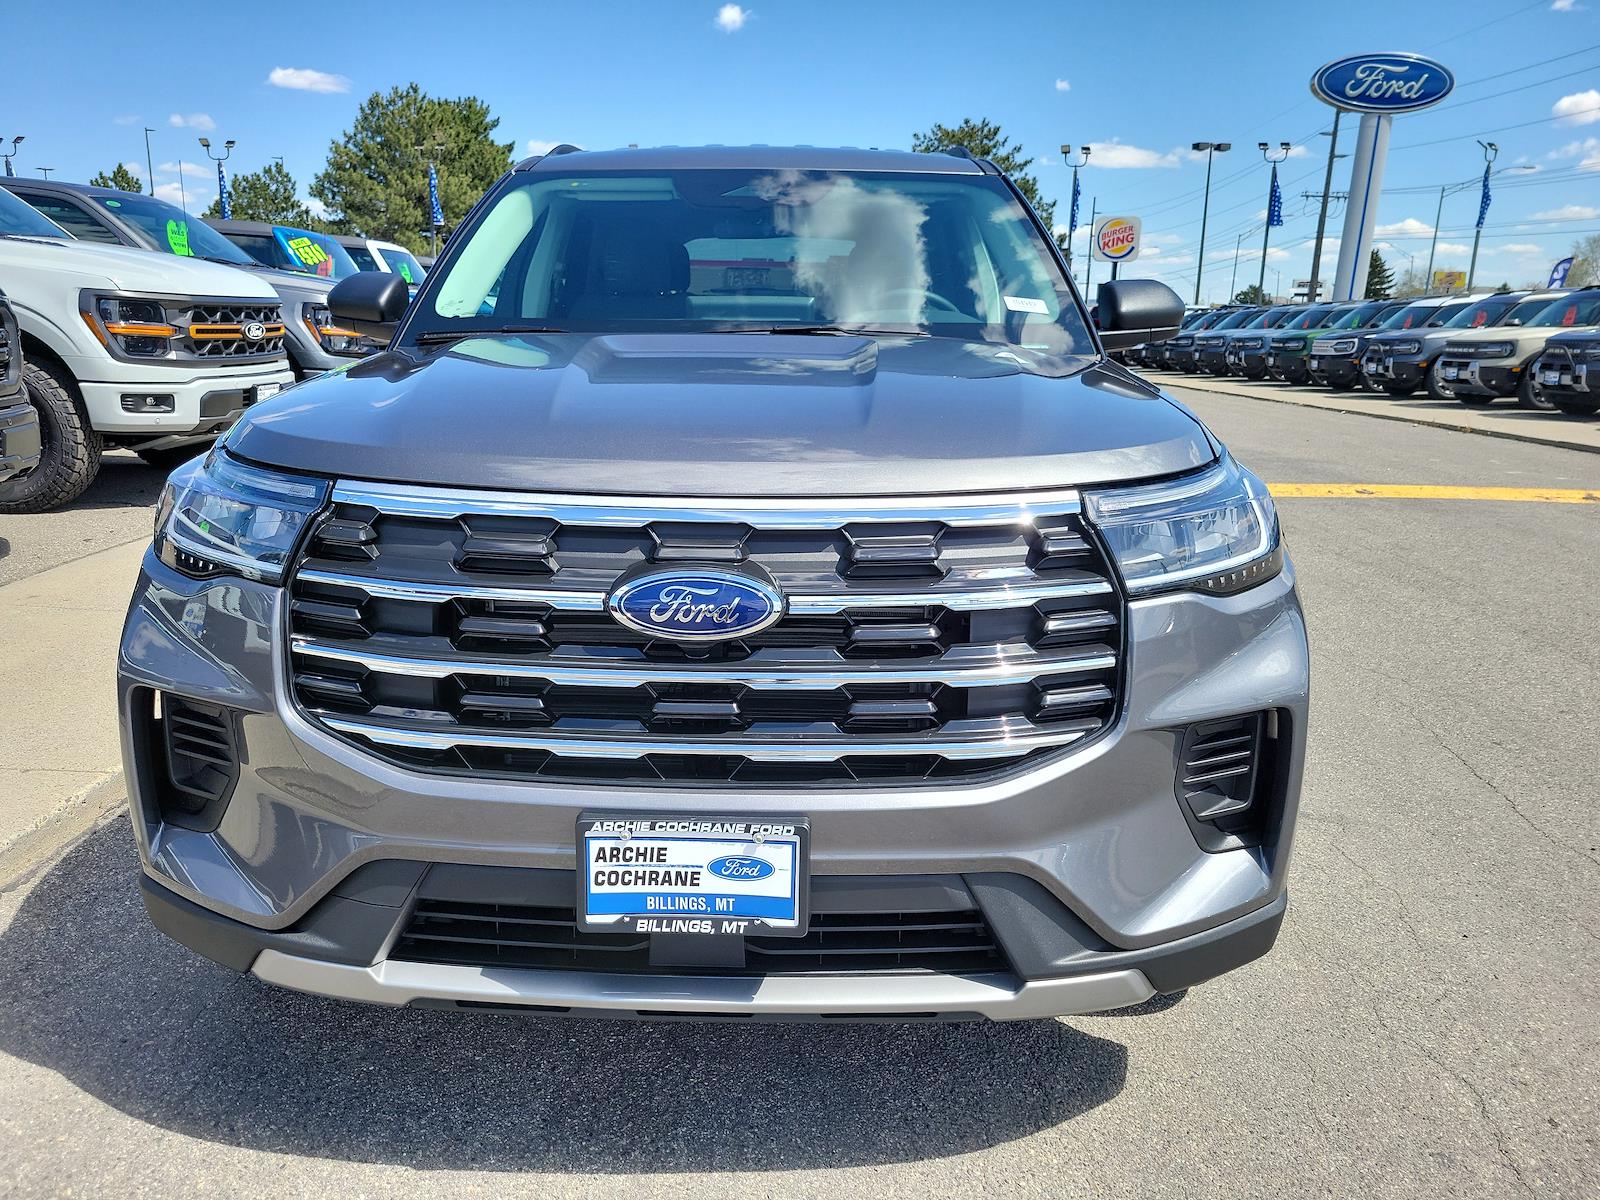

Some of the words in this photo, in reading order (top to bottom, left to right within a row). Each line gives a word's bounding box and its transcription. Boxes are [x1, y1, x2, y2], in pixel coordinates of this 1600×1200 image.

[1344, 63, 1429, 99] Ford
[1102, 225, 1134, 240] BURGER
[1102, 233, 1135, 250] KING
[649, 585, 741, 624] Ford
[590, 821, 651, 832] ARCHIE
[655, 821, 746, 834] COCHRANE
[750, 824, 795, 836] FORD
[594, 847, 668, 863] ARCHIE
[721, 858, 760, 876] Ford
[594, 870, 701, 886] COCHRANE
[646, 896, 711, 913] BILLINGS,
[715, 897, 736, 911] MT
[636, 919, 715, 934] BILLINGS,
[721, 920, 748, 934] MT
